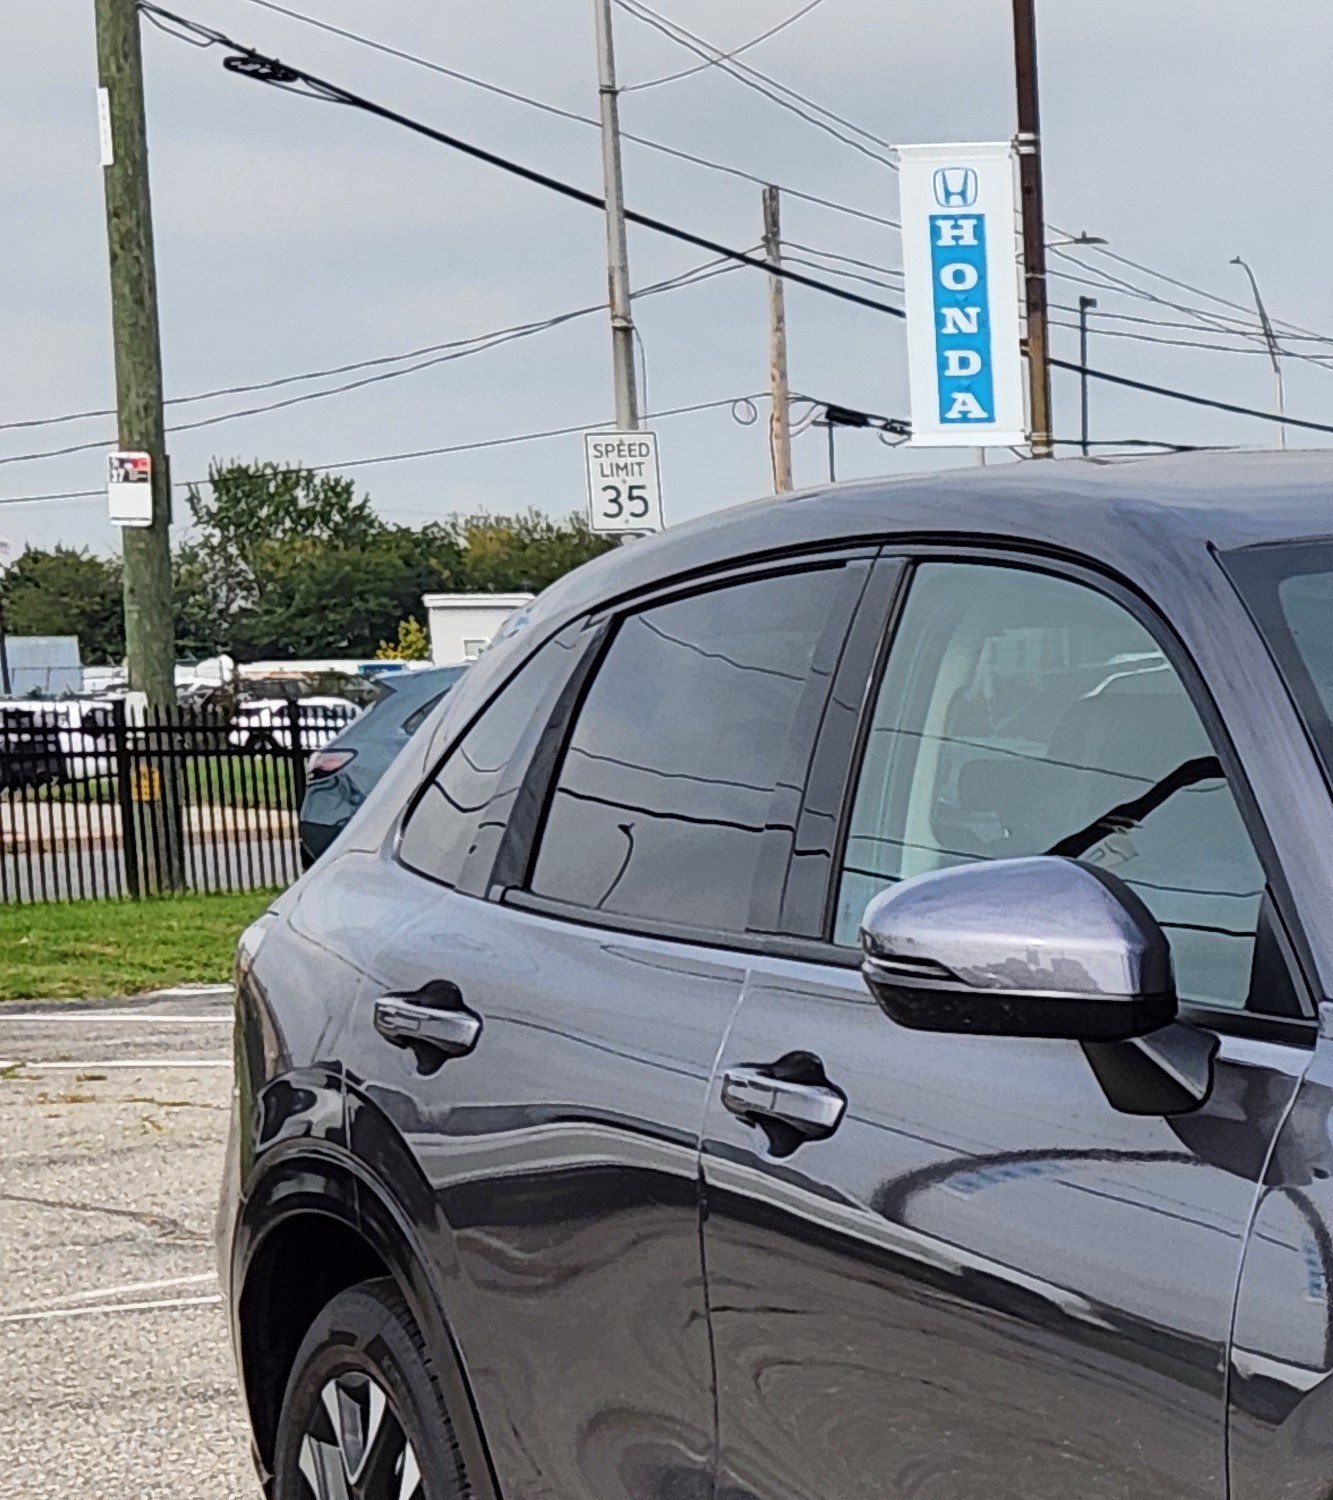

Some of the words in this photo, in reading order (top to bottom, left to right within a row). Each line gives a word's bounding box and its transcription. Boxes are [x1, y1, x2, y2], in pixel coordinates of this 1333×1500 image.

[935, 218, 989, 420] HONDA
[592, 442, 651, 459] SPEED
[600, 461, 646, 478] LIMIT
[601, 484, 650, 519] 35
